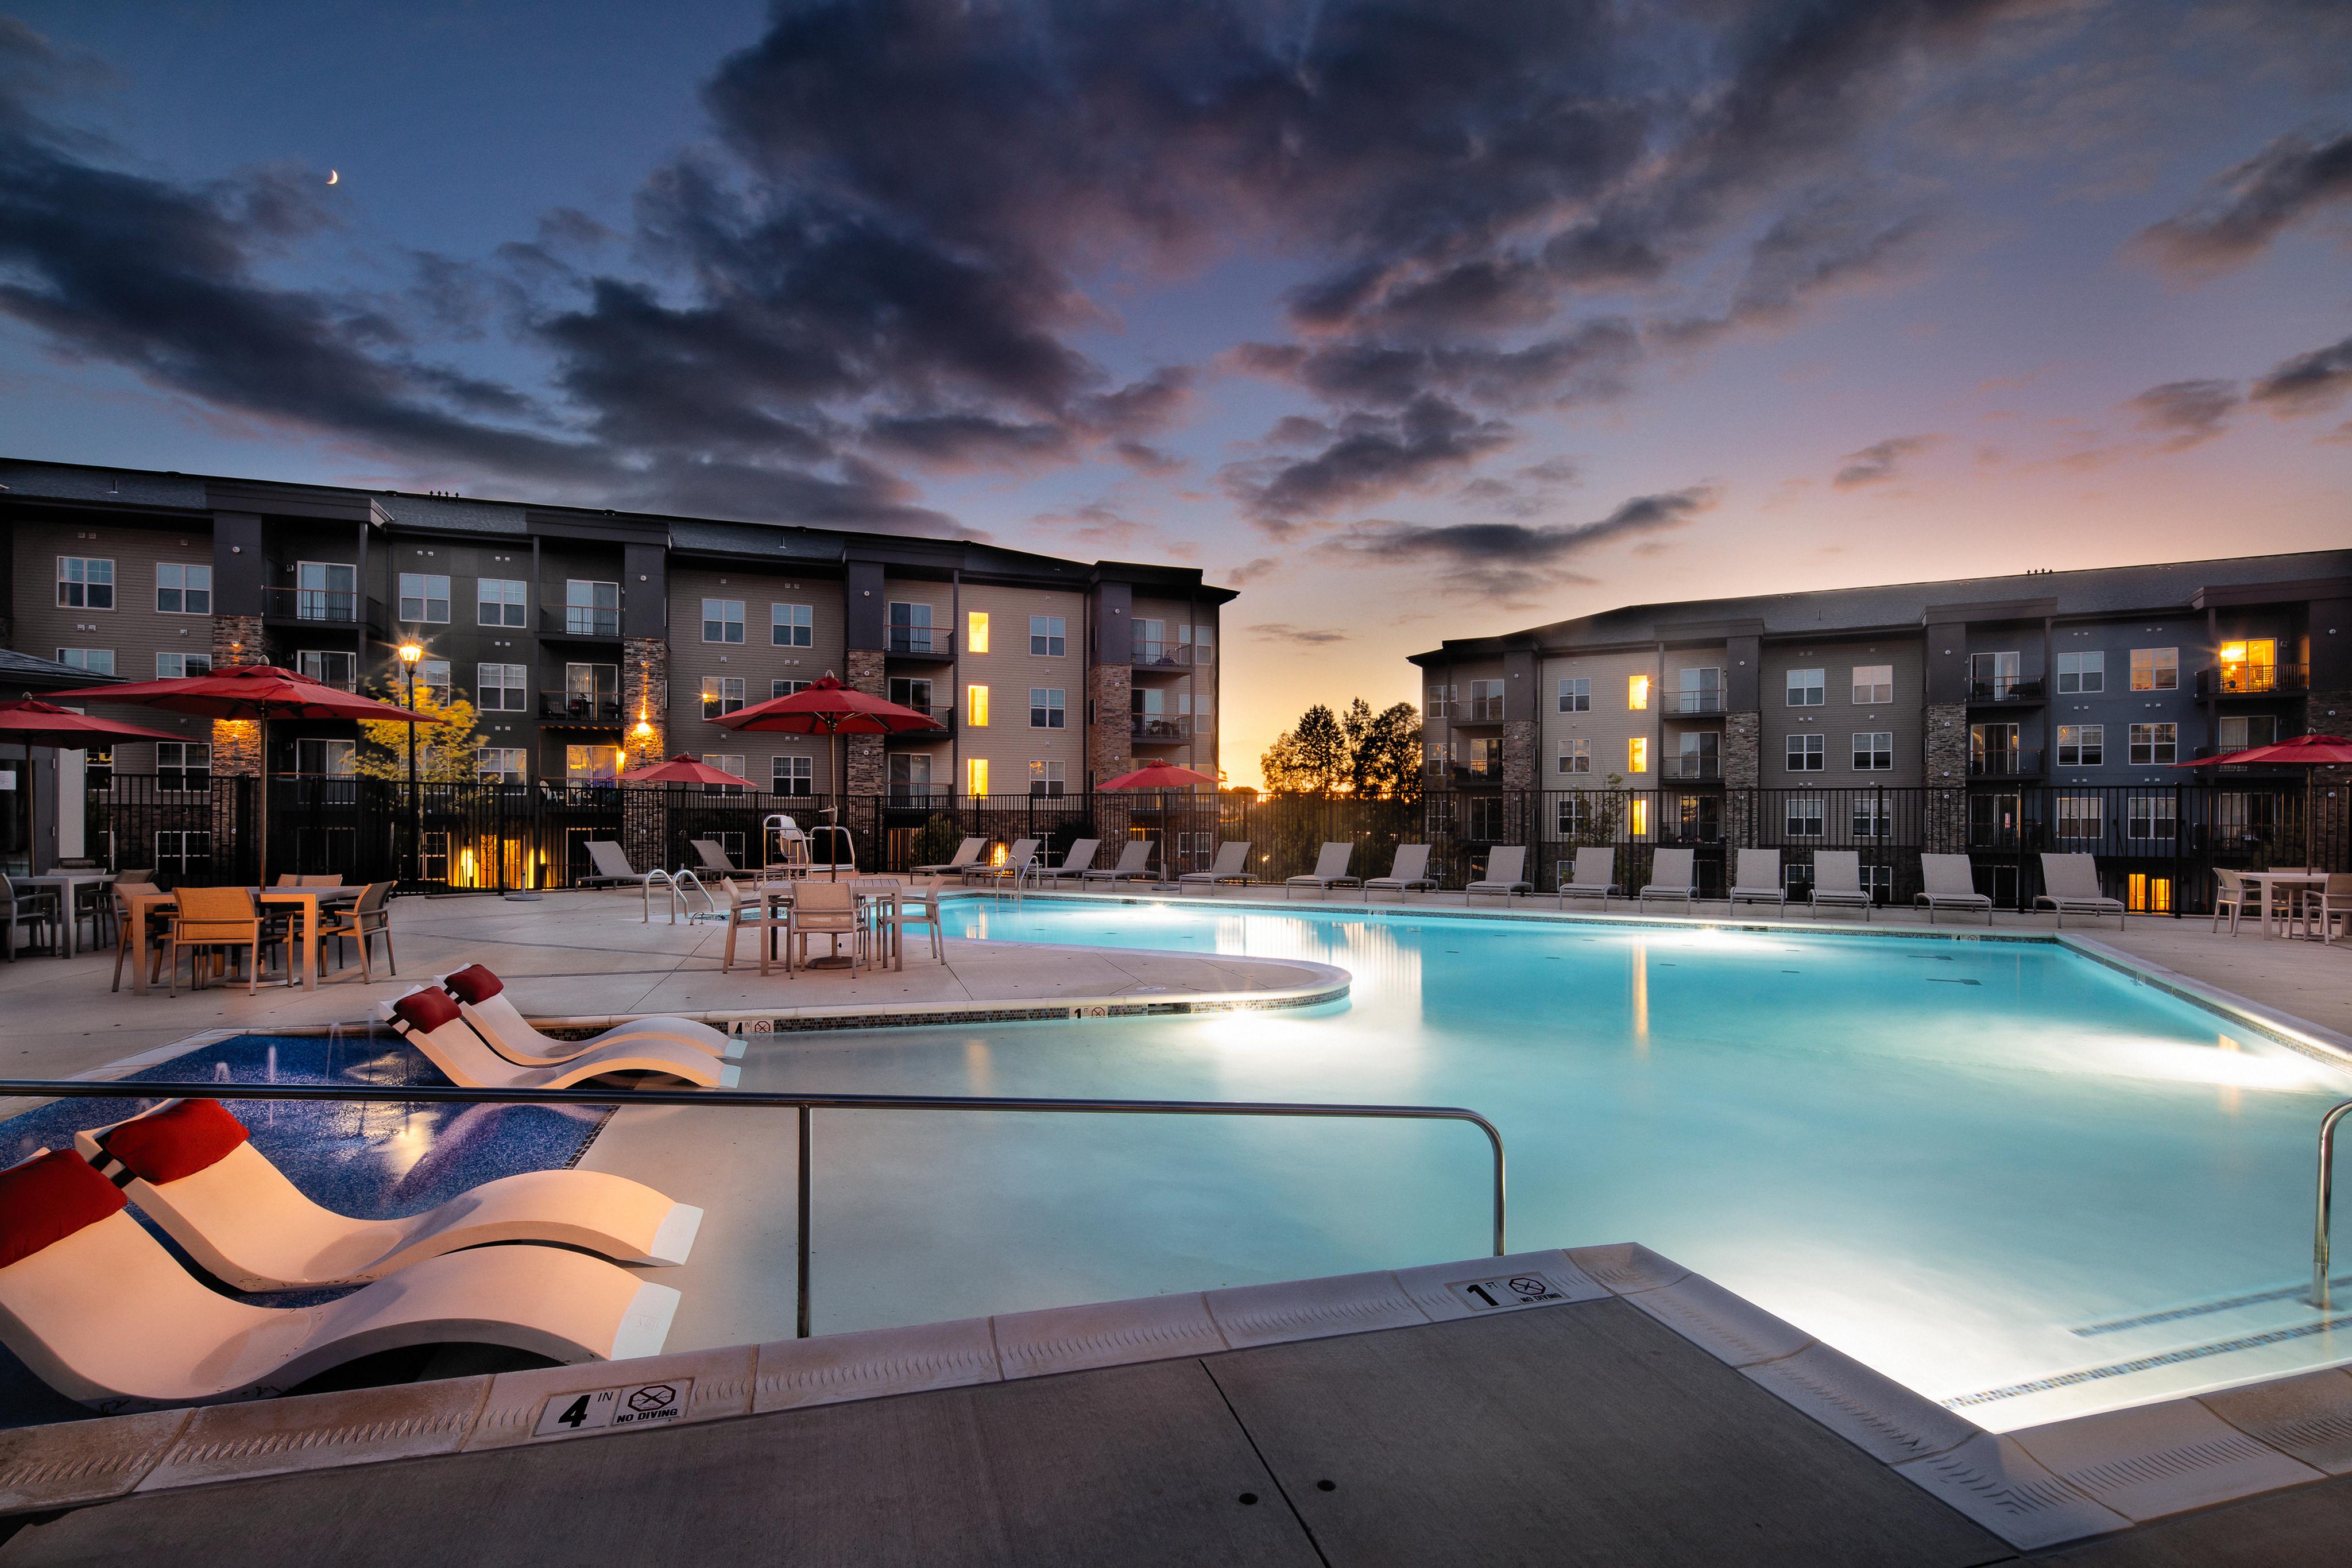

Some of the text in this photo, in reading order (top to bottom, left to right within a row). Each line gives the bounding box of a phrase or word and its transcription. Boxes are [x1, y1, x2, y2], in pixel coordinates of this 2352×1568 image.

[1074, 1008, 1081, 1019] 1
[1465, 1281, 1500, 1307] 1 FT
[1535, 1293, 1562, 1301] DIVING
[558, 1391, 614, 1428] 4 IN
[616, 1408, 678, 1423] NO DIVING
